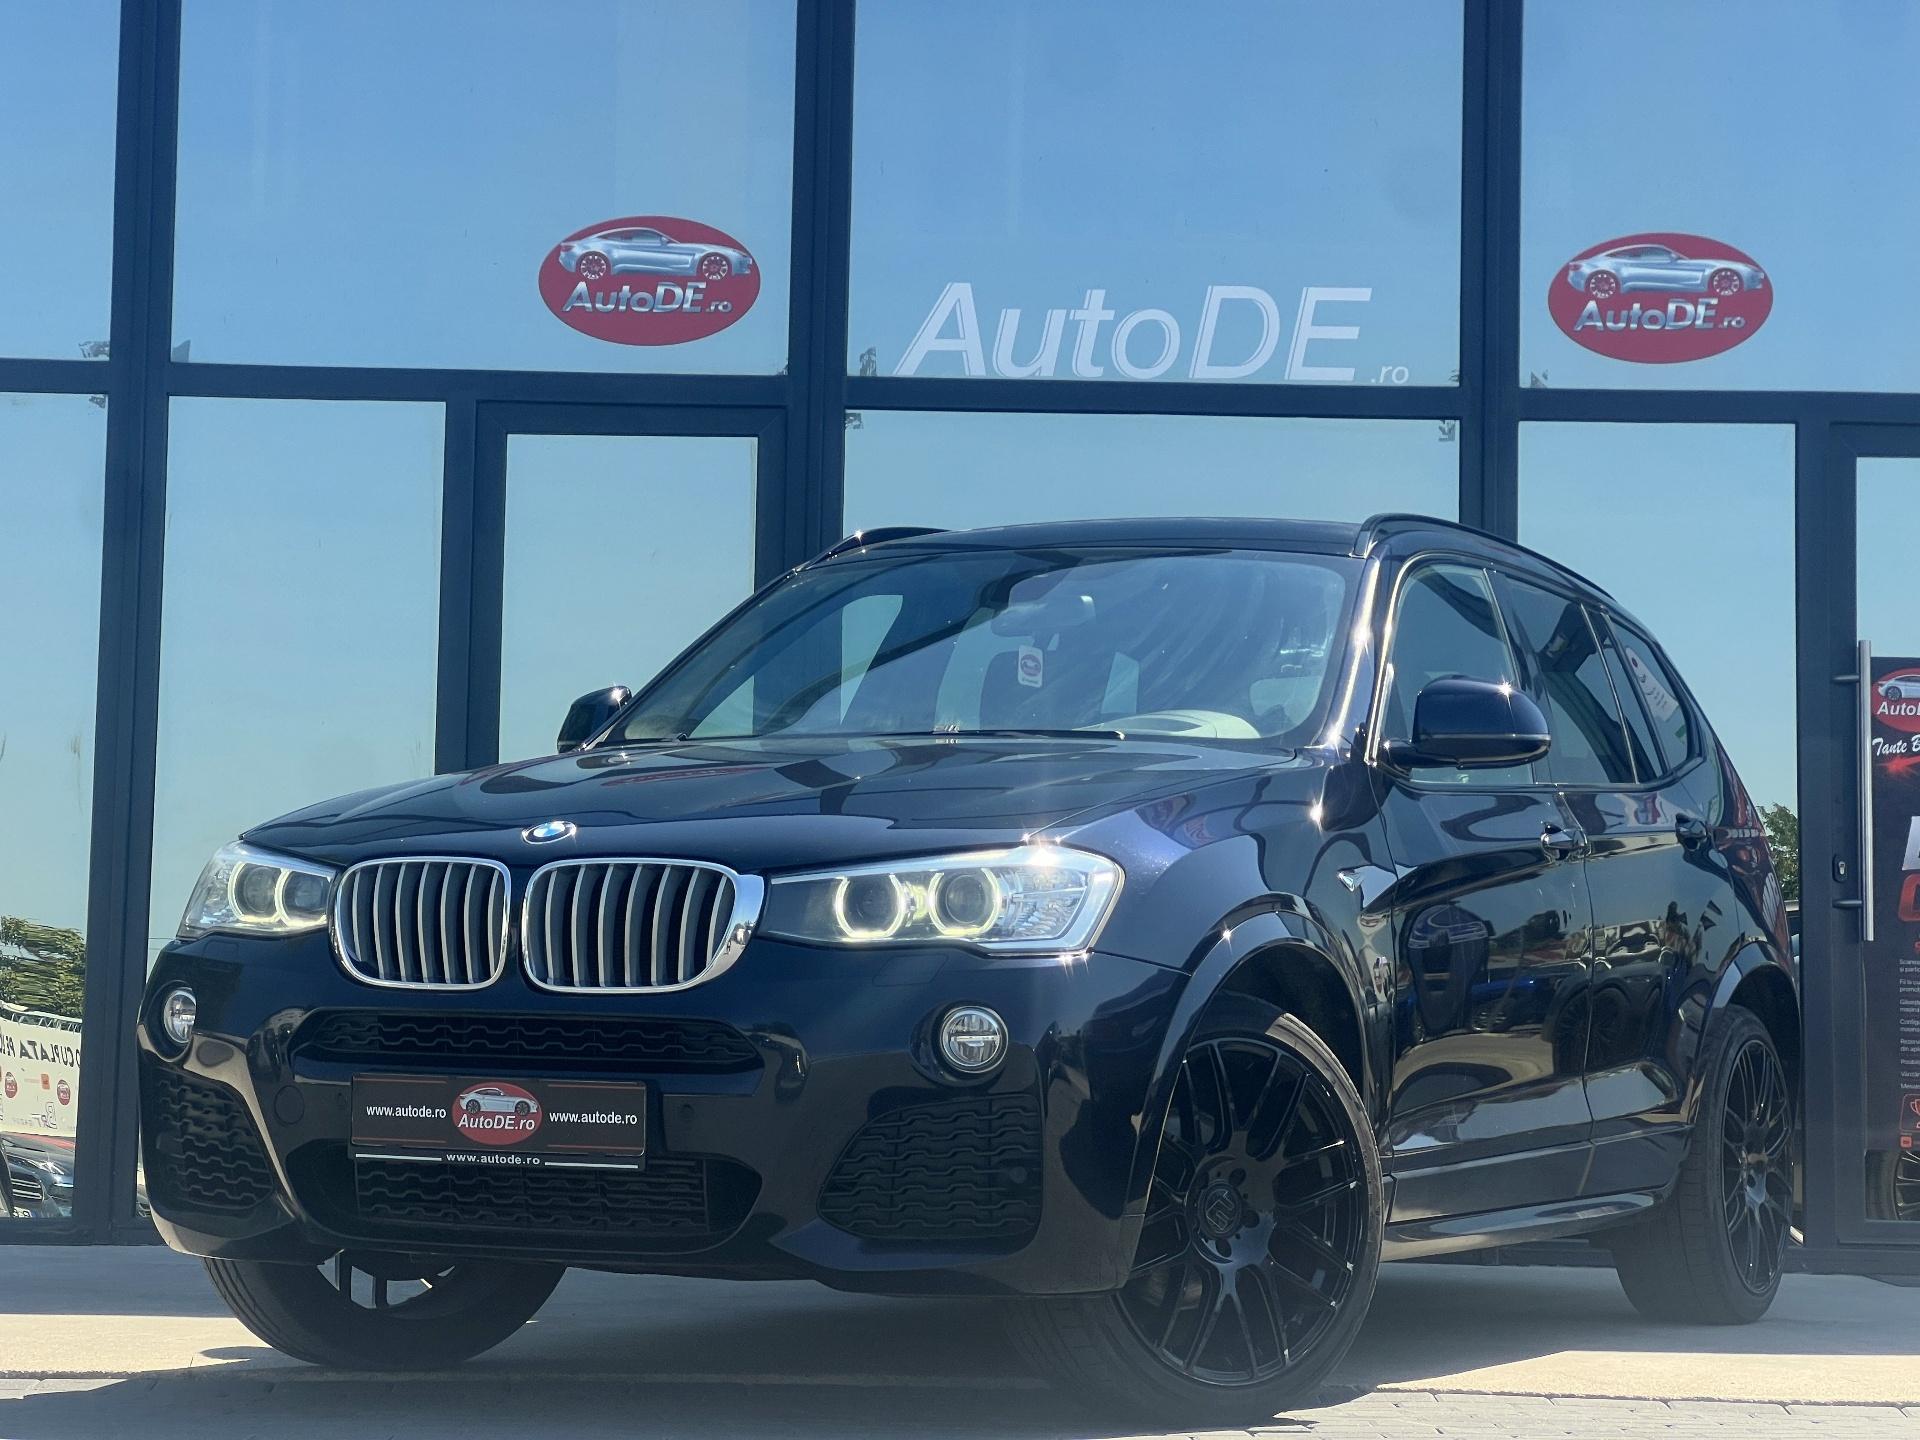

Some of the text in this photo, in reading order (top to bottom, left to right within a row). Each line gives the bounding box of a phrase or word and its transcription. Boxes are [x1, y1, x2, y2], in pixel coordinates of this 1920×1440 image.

[1877, 701, 1920, 716] Auto
[1872, 737, 1907, 756] Tante
[366, 1104, 446, 1119] www.autode.ro
[549, 1111, 638, 1125] www.autode.ro
[457, 1113, 536, 1131] AutoDE.ro
[446, 1153, 541, 1165] www.autode.ro
